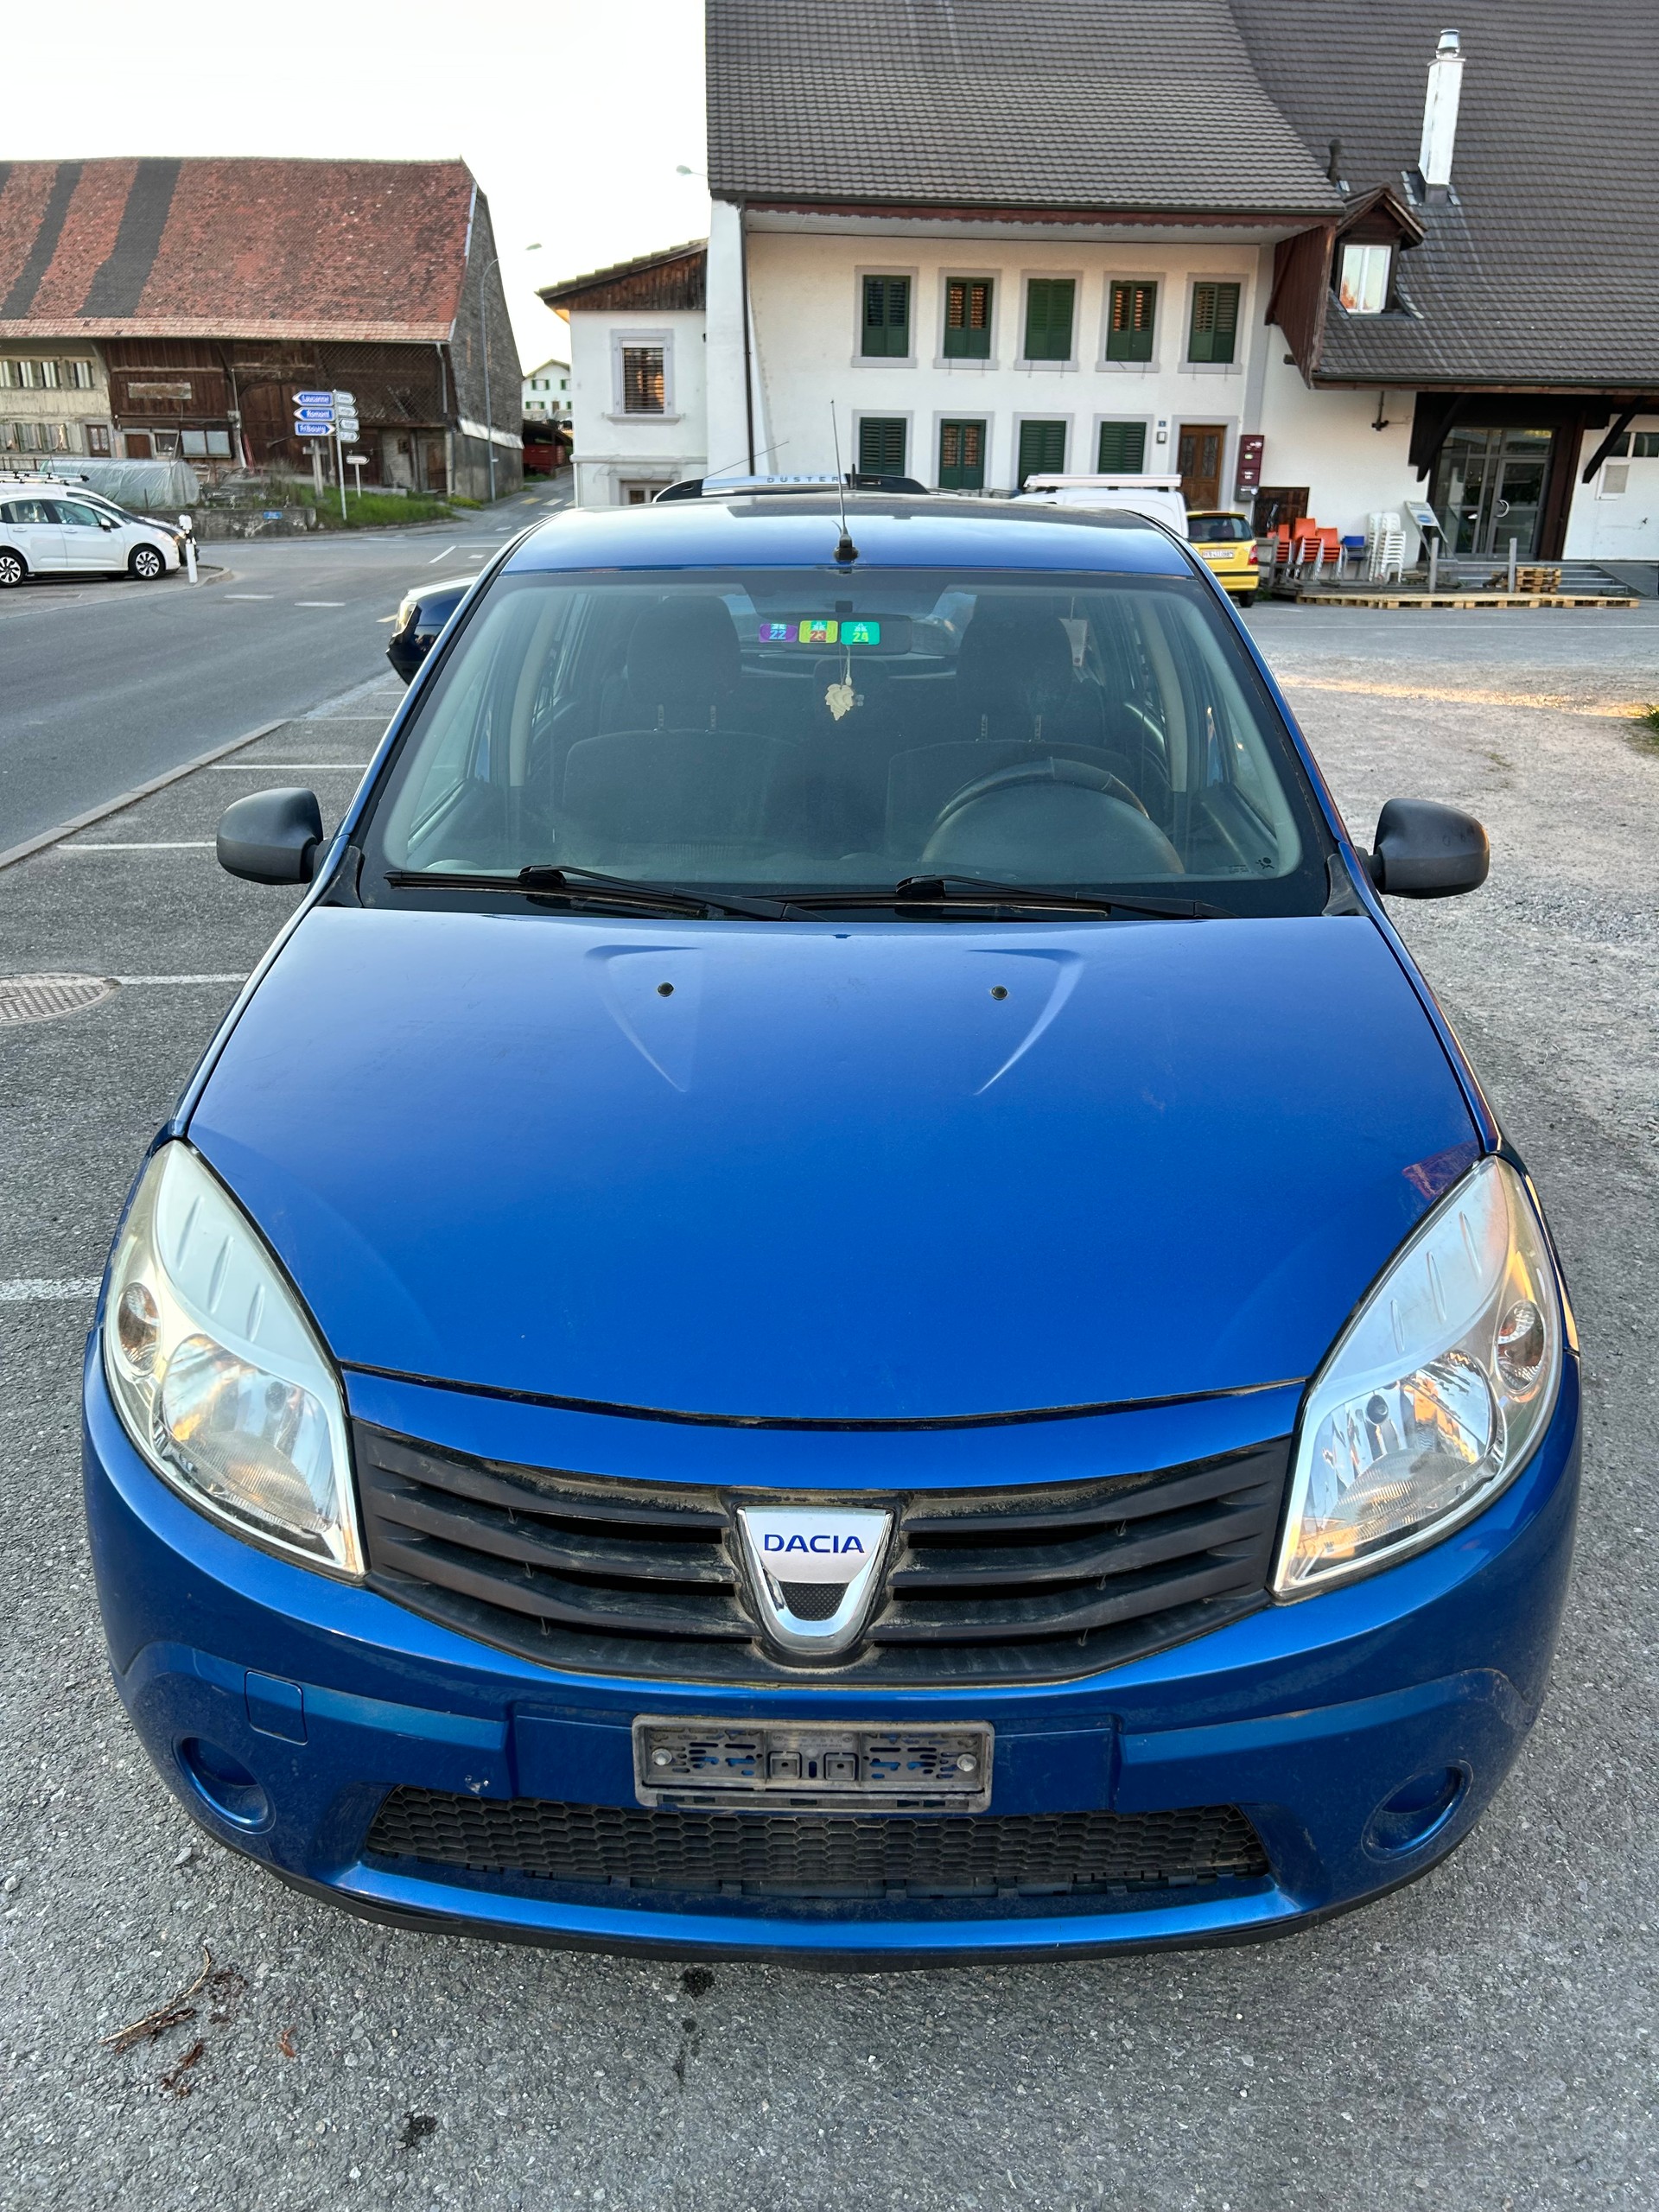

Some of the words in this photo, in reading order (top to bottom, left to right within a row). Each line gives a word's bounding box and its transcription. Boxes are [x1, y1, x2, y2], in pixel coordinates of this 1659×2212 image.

[769, 630, 785, 639] 22
[810, 631, 827, 640] 23
[852, 632, 869, 642] 24
[764, 1534, 865, 1554] DACIA
